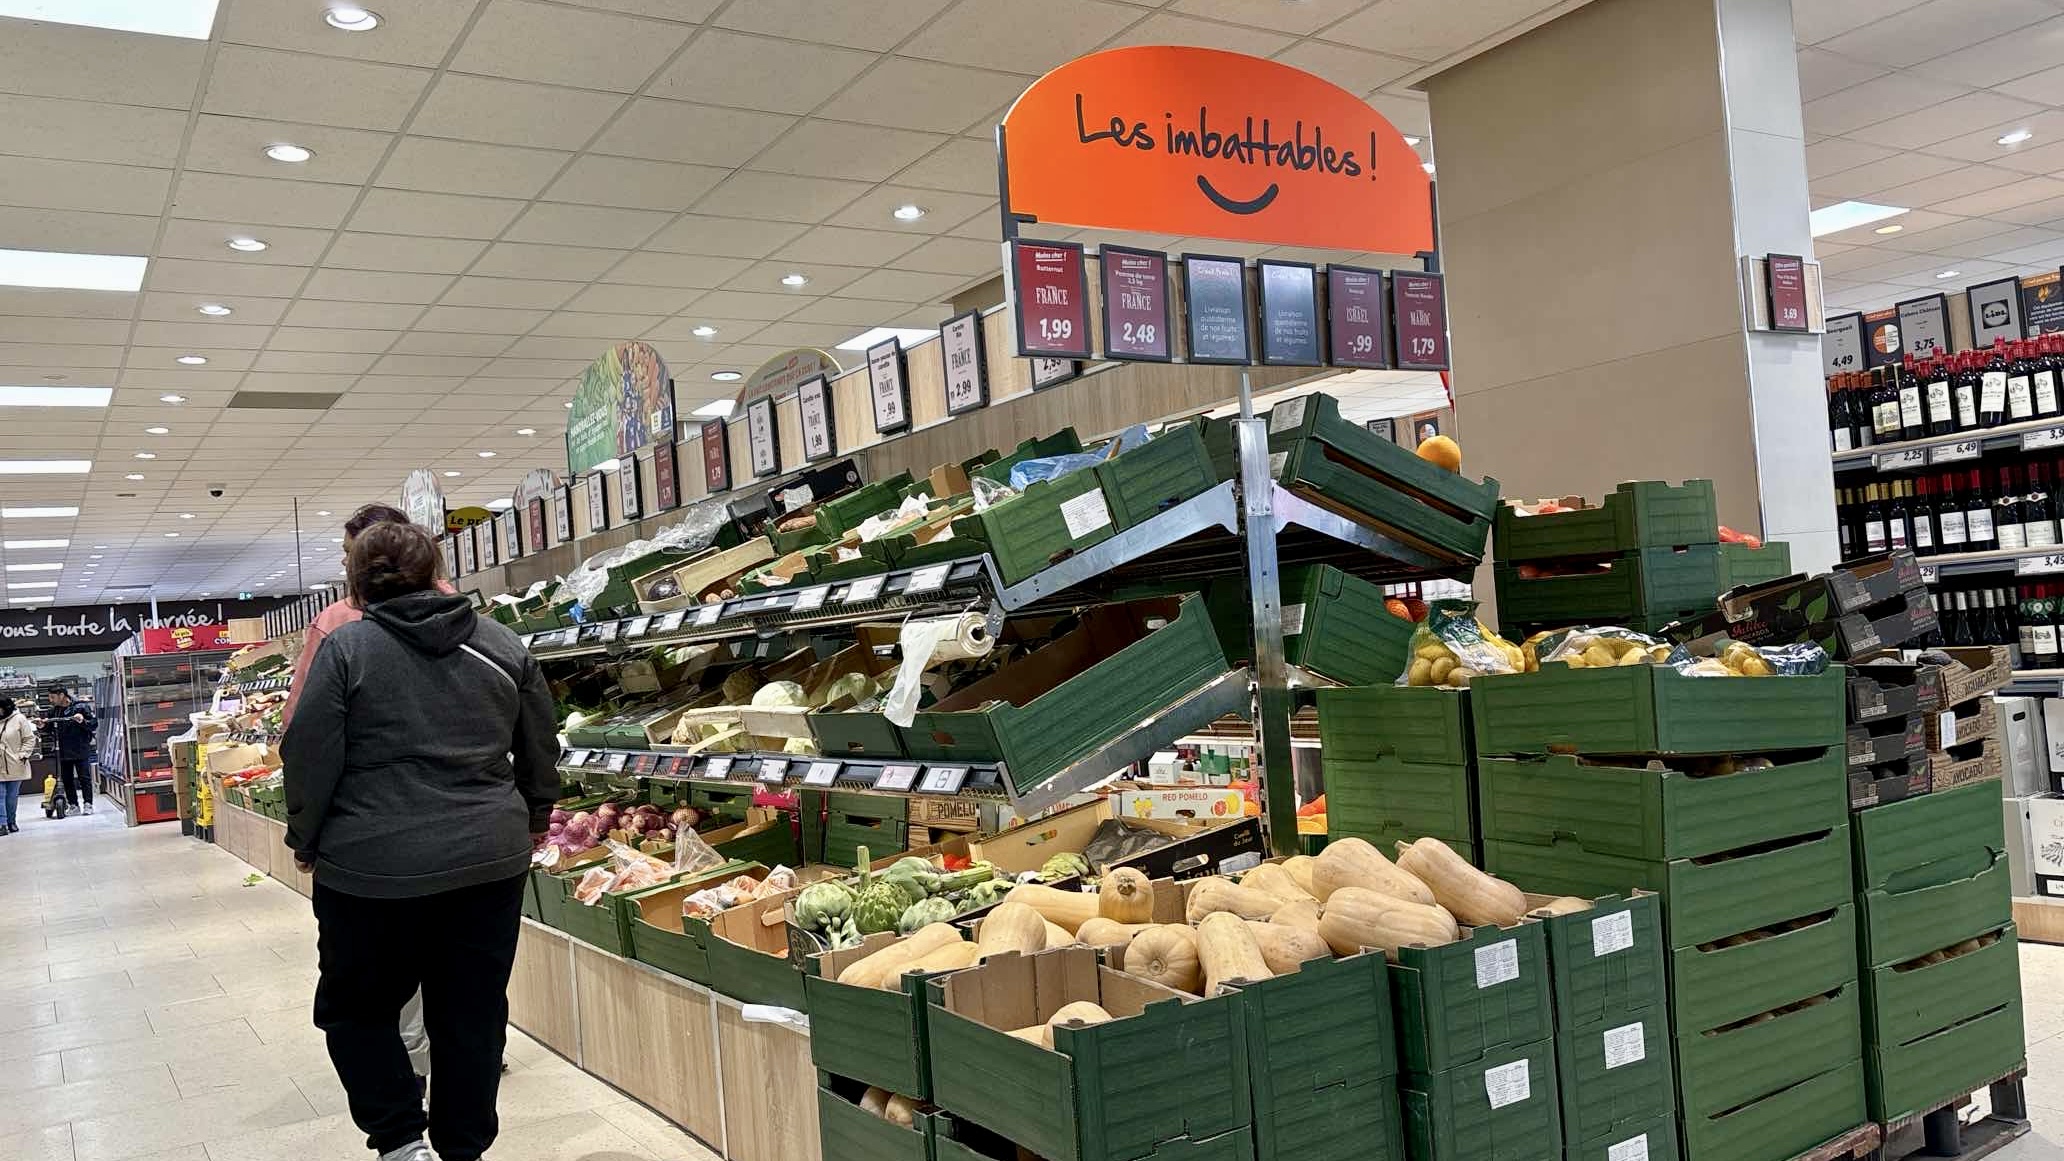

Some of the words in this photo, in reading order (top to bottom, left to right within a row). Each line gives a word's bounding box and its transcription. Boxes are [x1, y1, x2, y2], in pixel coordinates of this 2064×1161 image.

[1075, 93, 1155, 150] Les
[1165, 106, 1361, 177] imbattables
[1370, 131, 1377, 182] !
[1036, 285, 1069, 306] FRANCE
[1121, 292, 1152, 311] FRANCE
[1040, 317, 1072, 341] 1,99
[1122, 322, 1155, 345] 2,48
[1412, 337, 1435, 357] 1,79
[1914, 337, 1935, 352] 3,75
[1832, 354, 1854, 367] 4,49
[956, 379, 972, 398] 2,99
[1956, 442, 1977, 454] 6,49
[451, 516, 465, 526] Le
[42, 614, 106, 637] toute
[109, 606, 132, 632] la
[1964, 667, 1998, 697] AGUACATE
[1952, 763, 1983, 785] AVOCADO
[1162, 793, 1177, 802] RED
[1178, 792, 1208, 801] POMELO
